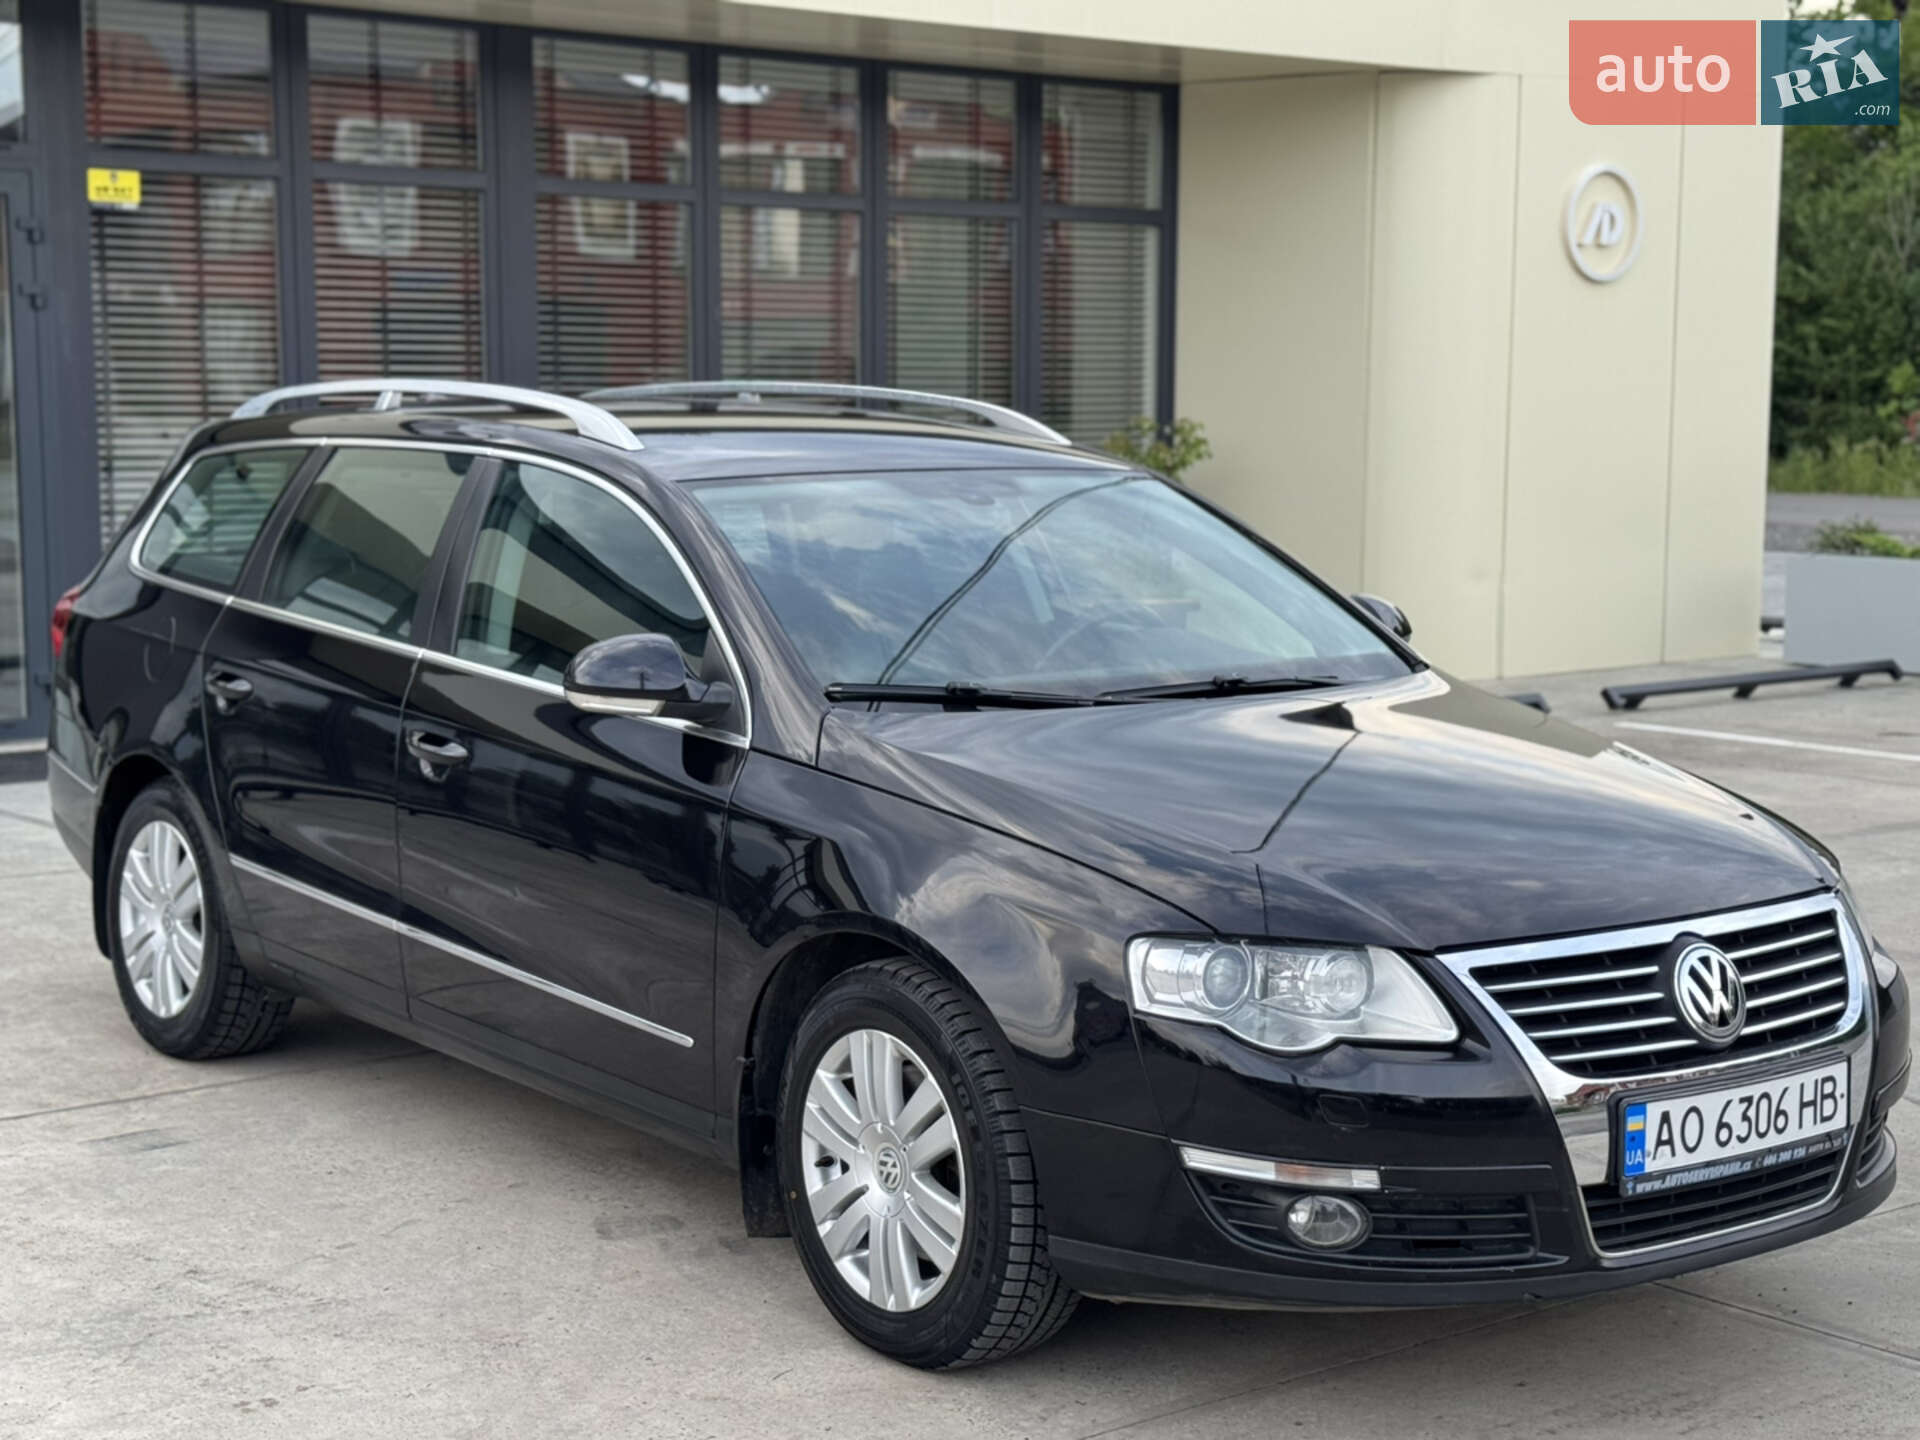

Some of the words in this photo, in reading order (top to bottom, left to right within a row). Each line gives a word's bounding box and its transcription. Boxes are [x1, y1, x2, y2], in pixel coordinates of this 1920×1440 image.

[1653, 1105, 1704, 1161] AO
[1715, 1086, 1790, 1148] 6306
[1797, 1075, 1838, 1130] HB
[1626, 1149, 1644, 1165] UA
